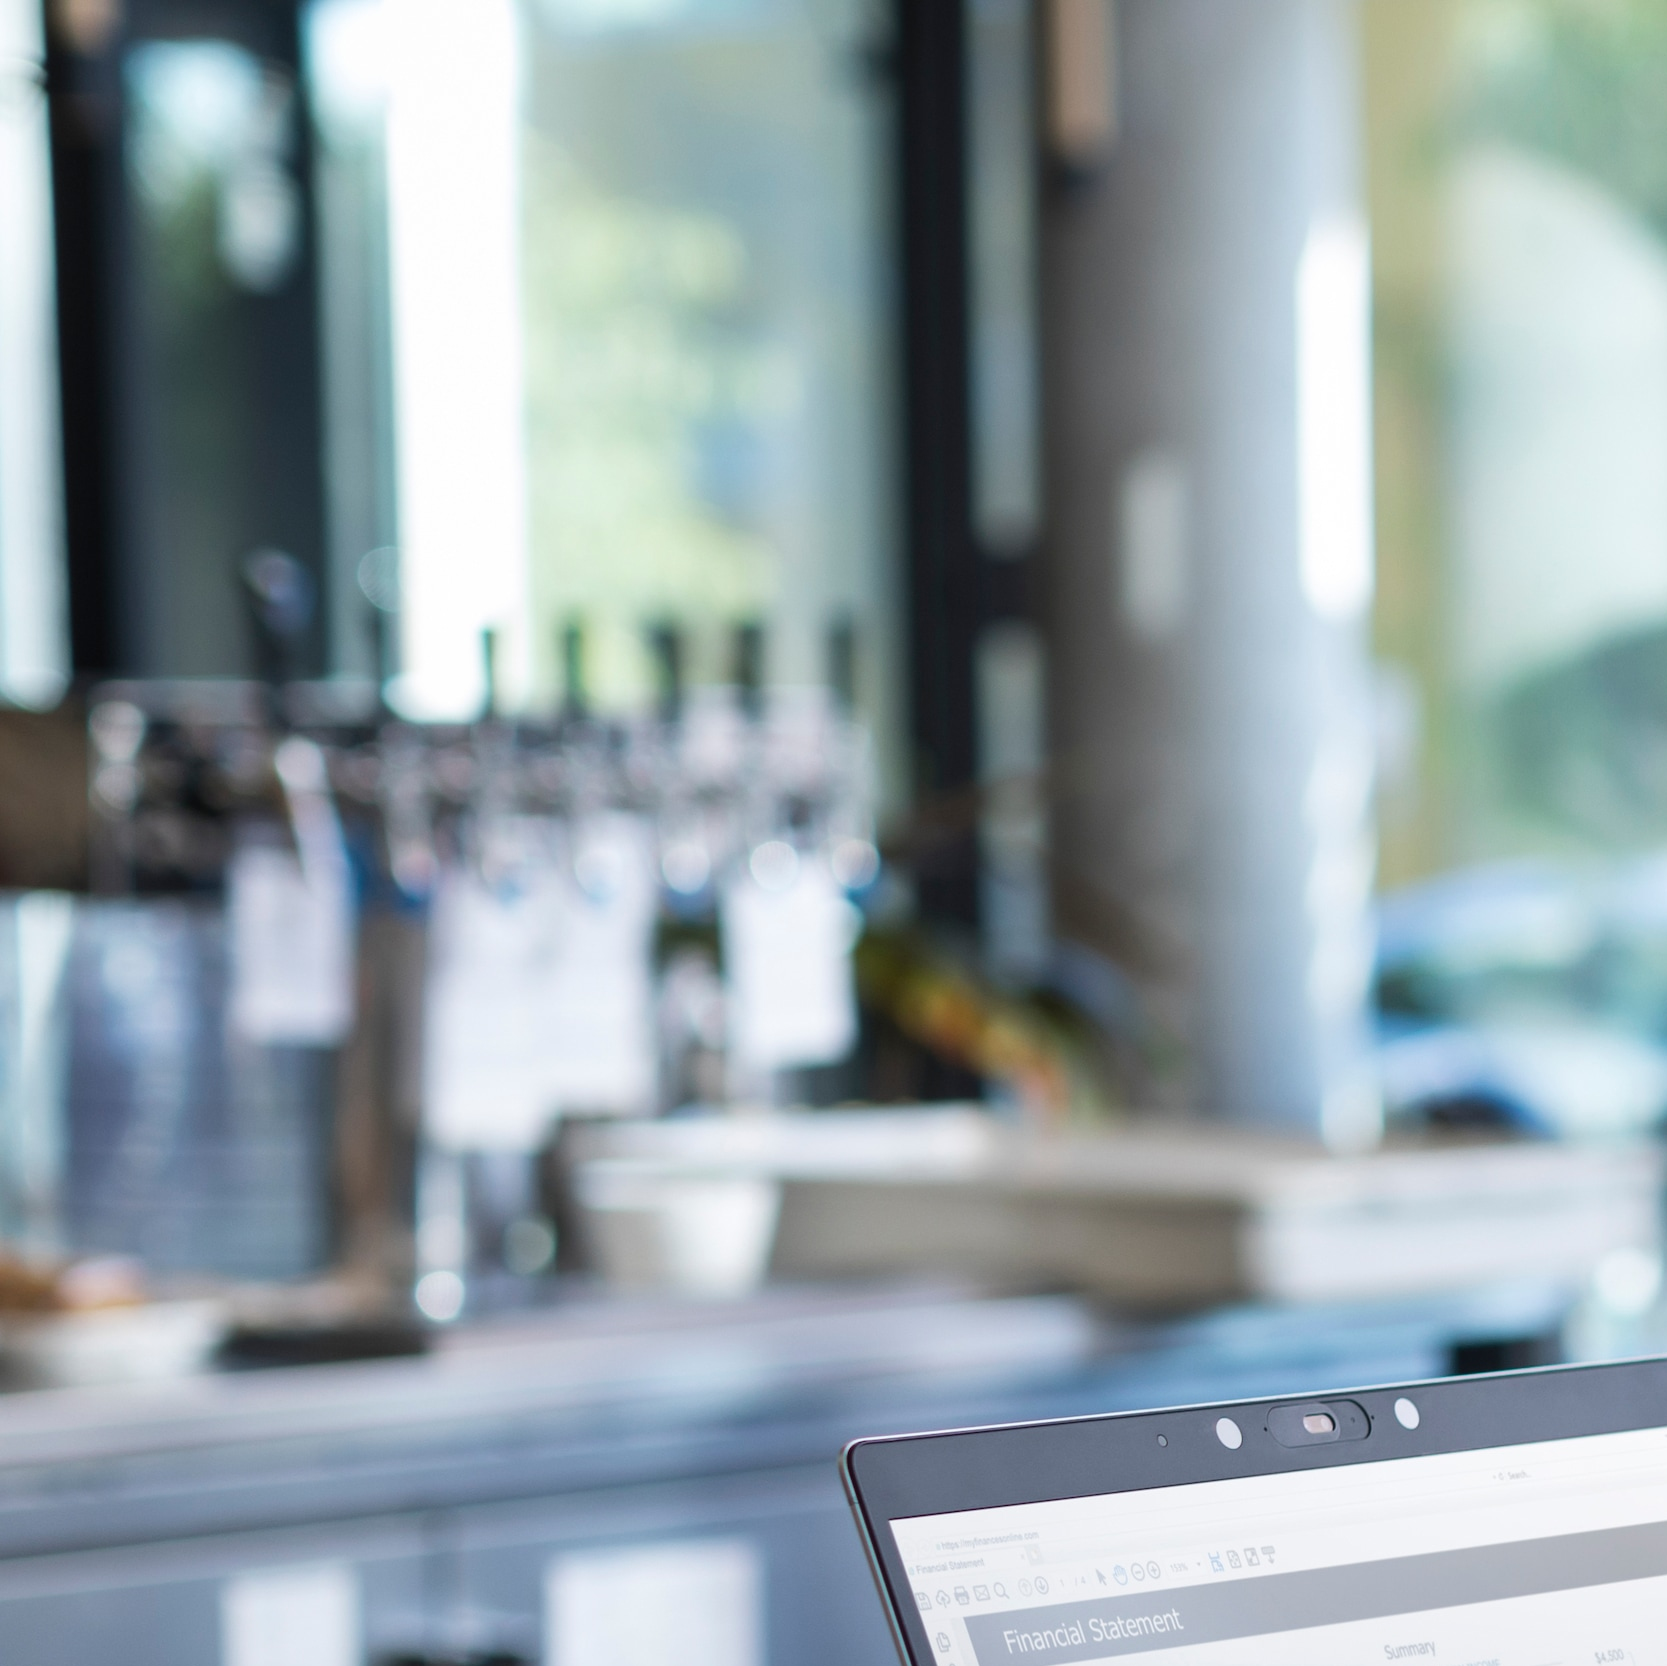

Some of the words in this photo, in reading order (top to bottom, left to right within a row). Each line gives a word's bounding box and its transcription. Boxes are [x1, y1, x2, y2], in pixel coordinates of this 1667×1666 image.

[916, 1561, 948, 1575] Financial
[948, 1558, 985, 1571] Statement
[1003, 1619, 1086, 1655] Financial
[1088, 1608, 1184, 1642] Statement
[1384, 1640, 1436, 1661] Summary
